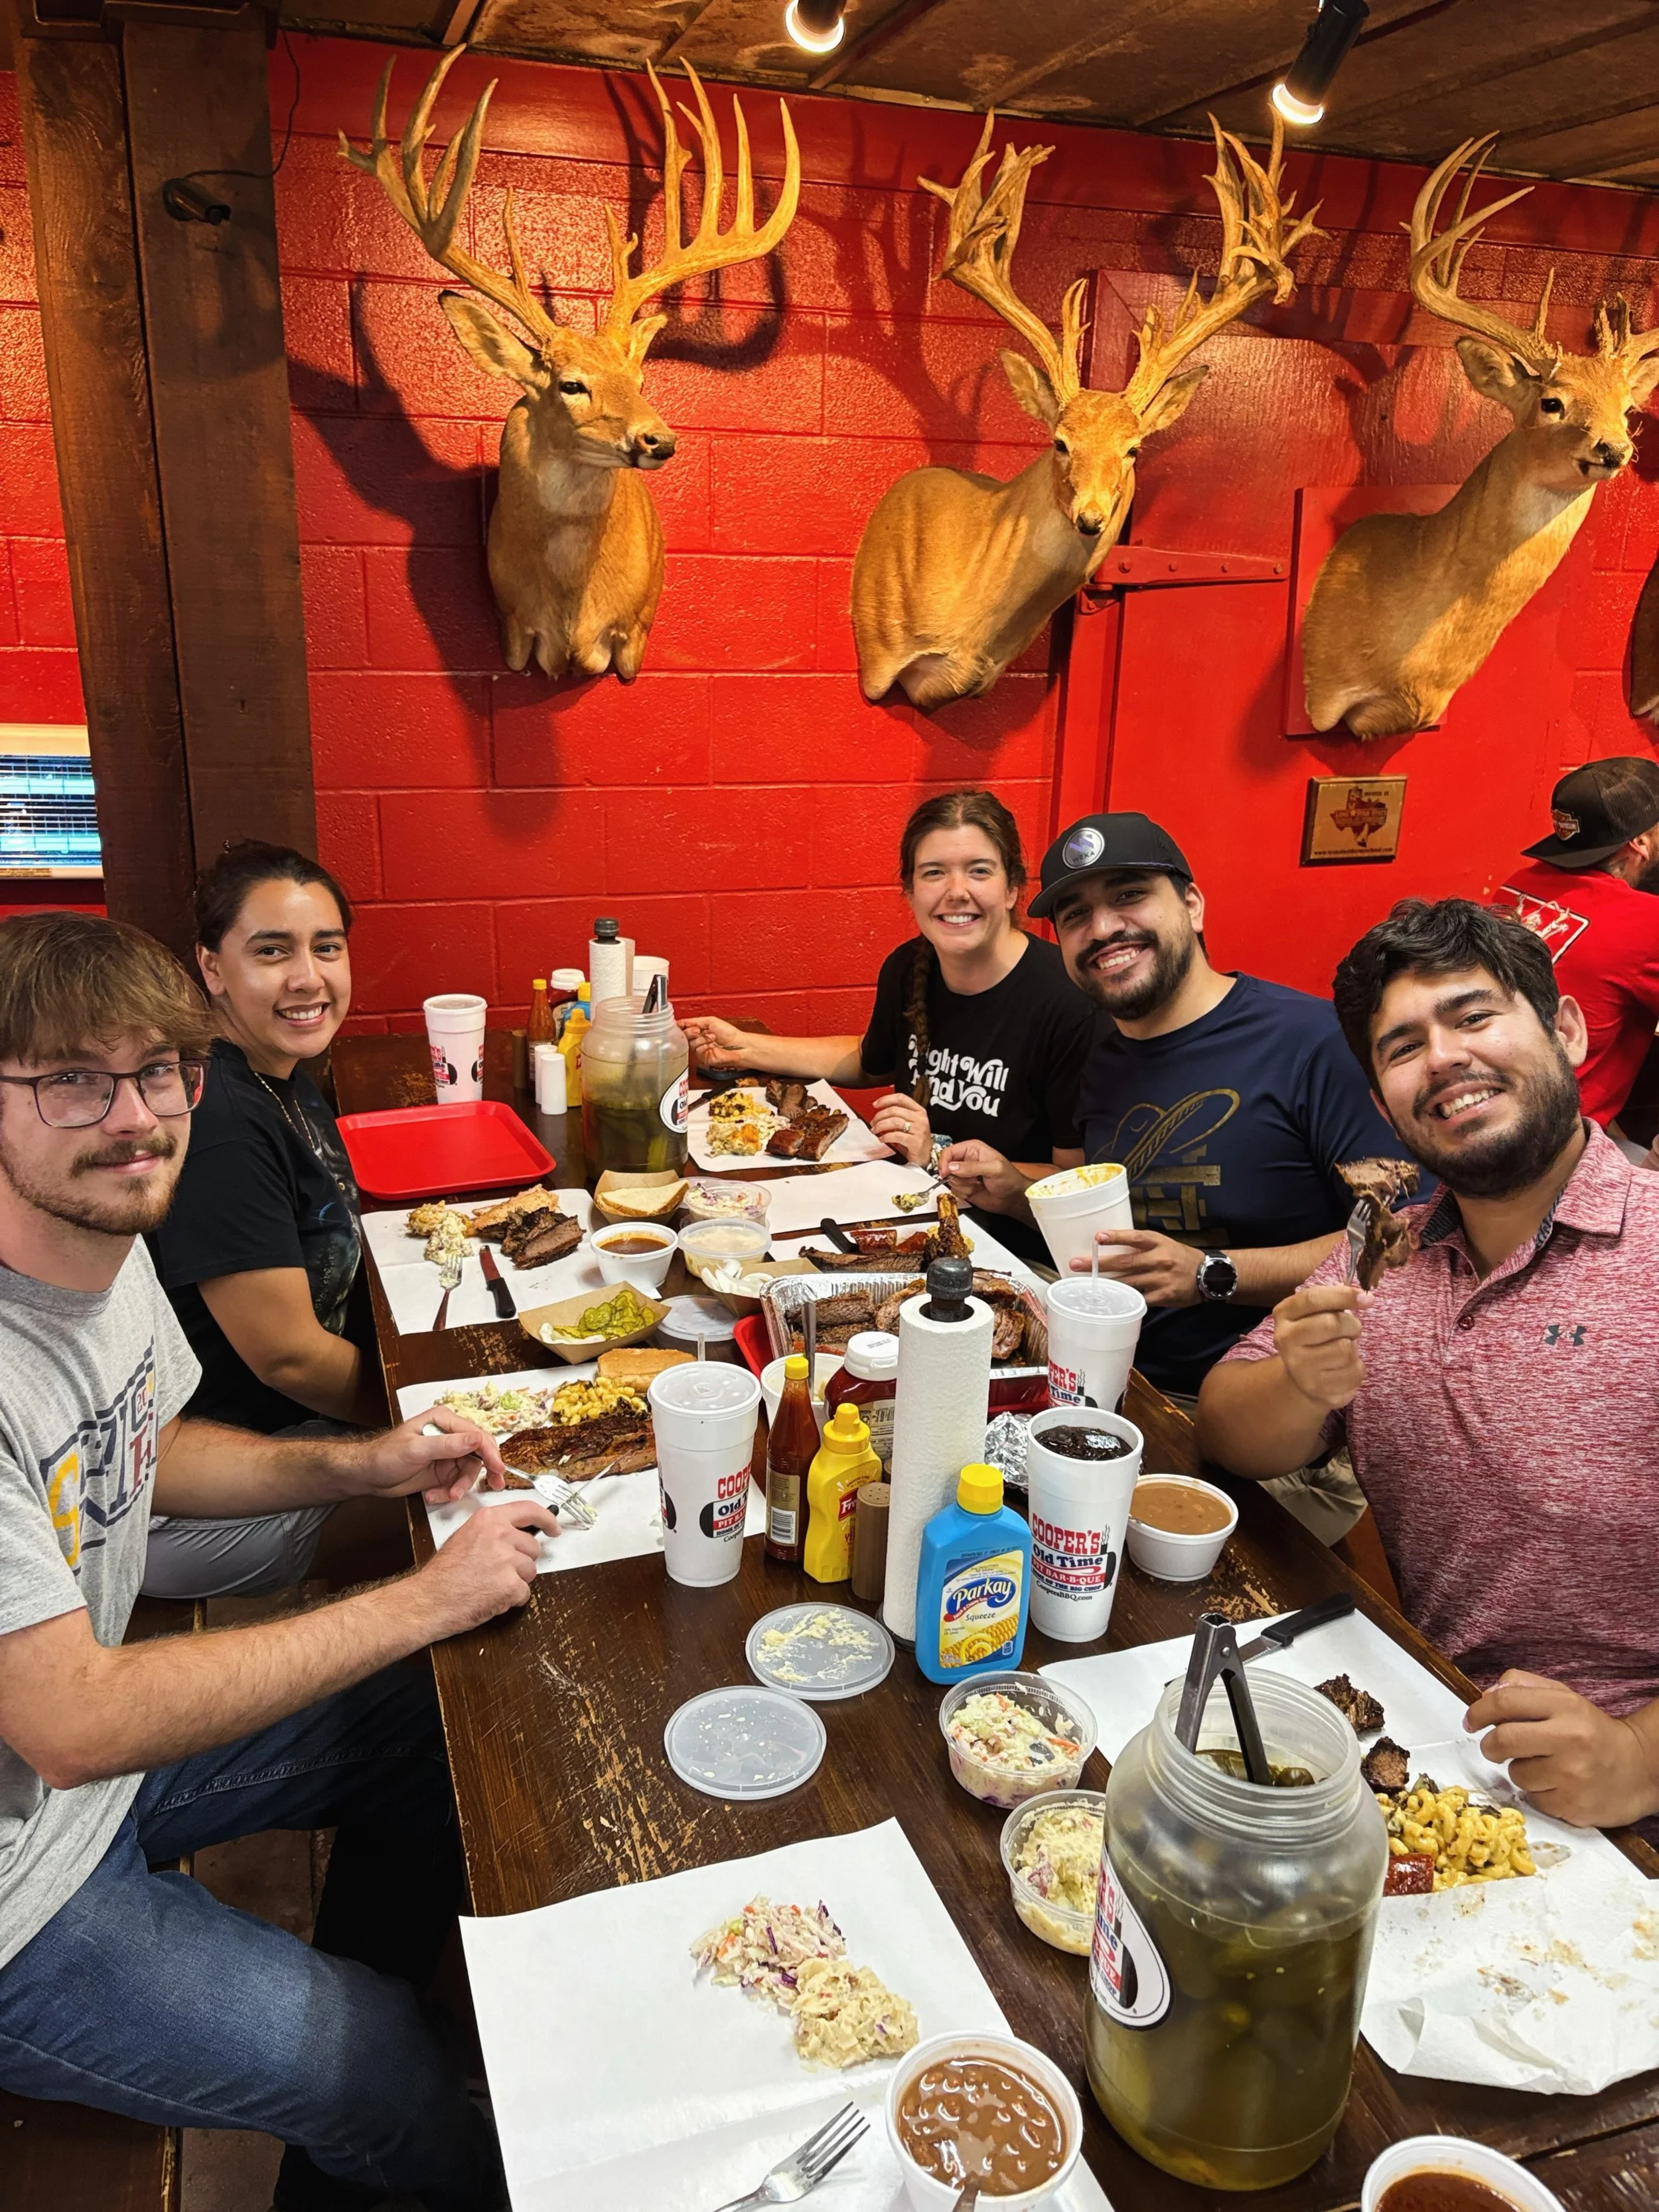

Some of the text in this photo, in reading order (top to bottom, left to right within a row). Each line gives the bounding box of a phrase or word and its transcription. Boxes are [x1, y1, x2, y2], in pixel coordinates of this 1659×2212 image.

[1072, 851, 1096, 863] WEKA
[960, 1056, 1009, 1092] Will
[930, 1079, 1001, 1118] You
[1050, 1385, 1081, 1404] Time
[718, 1498, 741, 1516] Old
[718, 1516, 733, 1528] PIT
[1033, 1512, 1100, 1554] COOPER'S
[1033, 1547, 1054, 1566] Old
[1056, 1555, 1104, 1568] Time
[952, 1578, 1013, 1611] Parkay
[1036, 1580, 1093, 1602] CoopersBBQ.com
[965, 1612, 996, 1623] Squeeze
